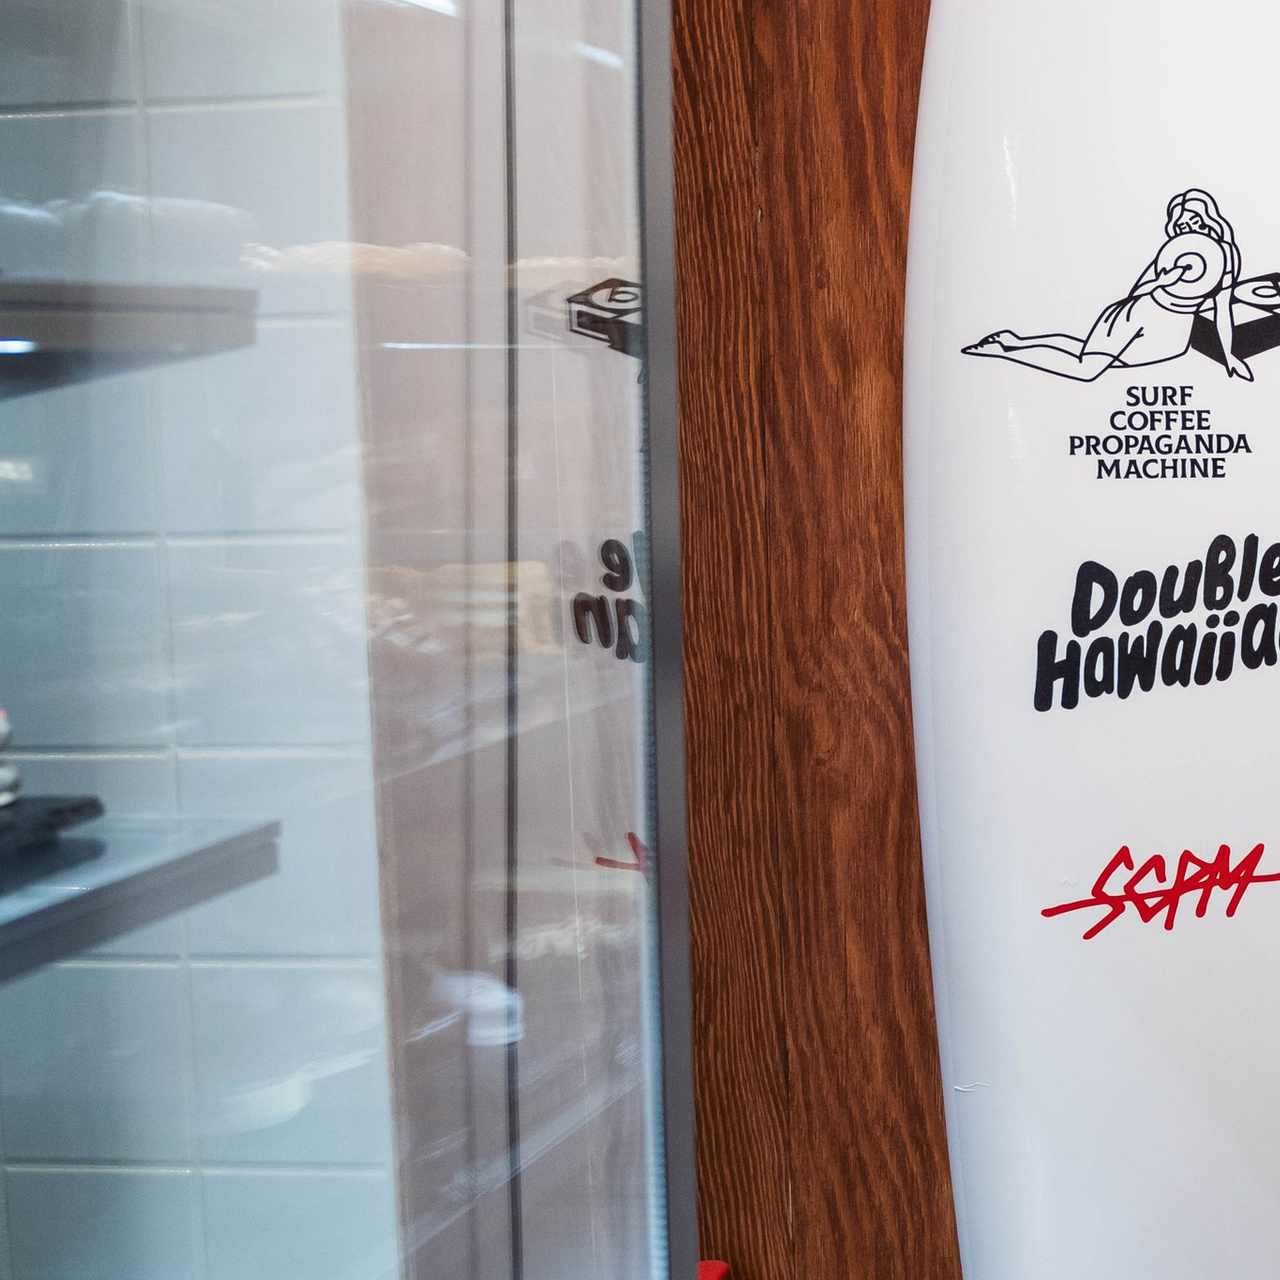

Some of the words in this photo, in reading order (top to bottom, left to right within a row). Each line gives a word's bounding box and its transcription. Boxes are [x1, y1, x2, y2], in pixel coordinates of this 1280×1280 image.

[1126, 385, 1194, 407] SURF
[1109, 409, 1211, 432] COFFEE
[1069, 433, 1253, 456] PROPAGANDA
[1096, 457, 1226, 480] MACHINE
